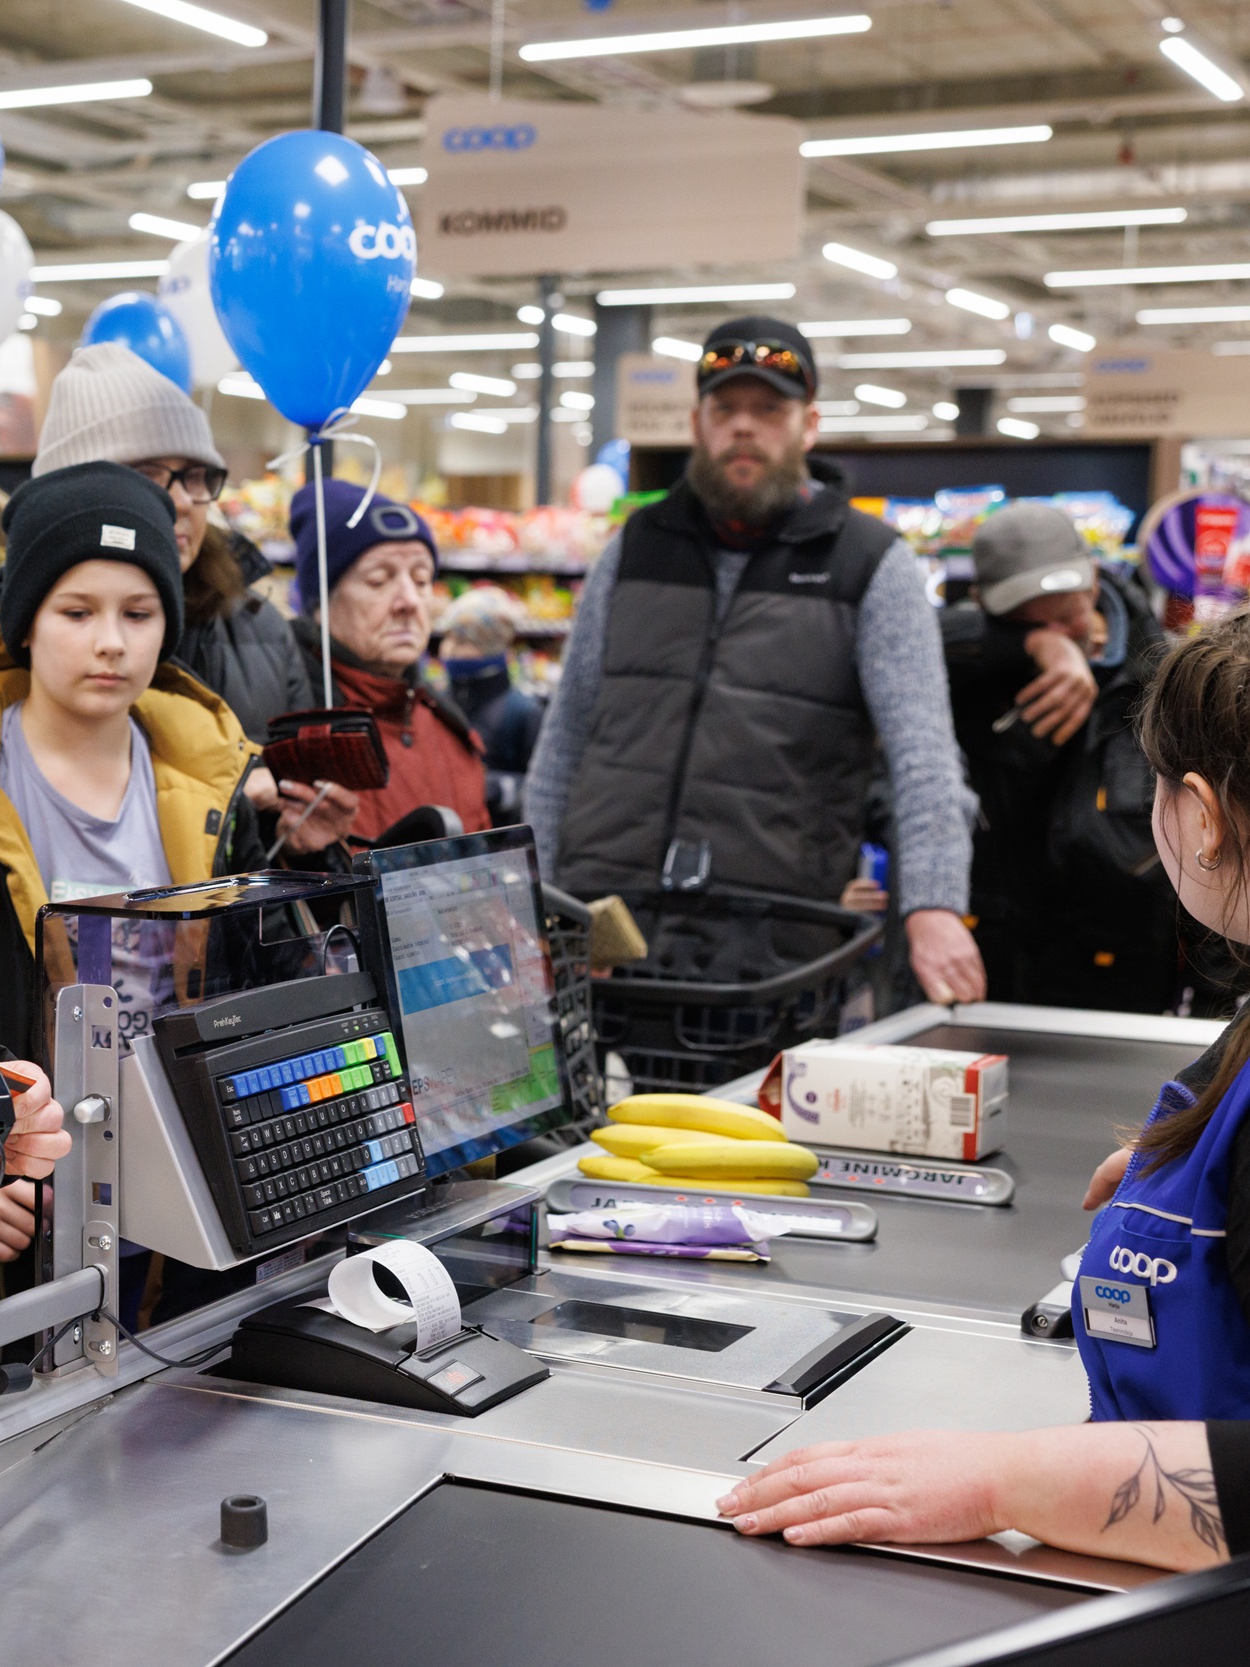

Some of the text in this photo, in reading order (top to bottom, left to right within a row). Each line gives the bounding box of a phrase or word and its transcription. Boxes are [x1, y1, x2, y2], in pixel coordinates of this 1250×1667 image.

[442, 122, 538, 154] coop
[439, 205, 569, 238] KOMMID
[1109, 1245, 1178, 1287] coop
[1095, 1285, 1132, 1305] coop
